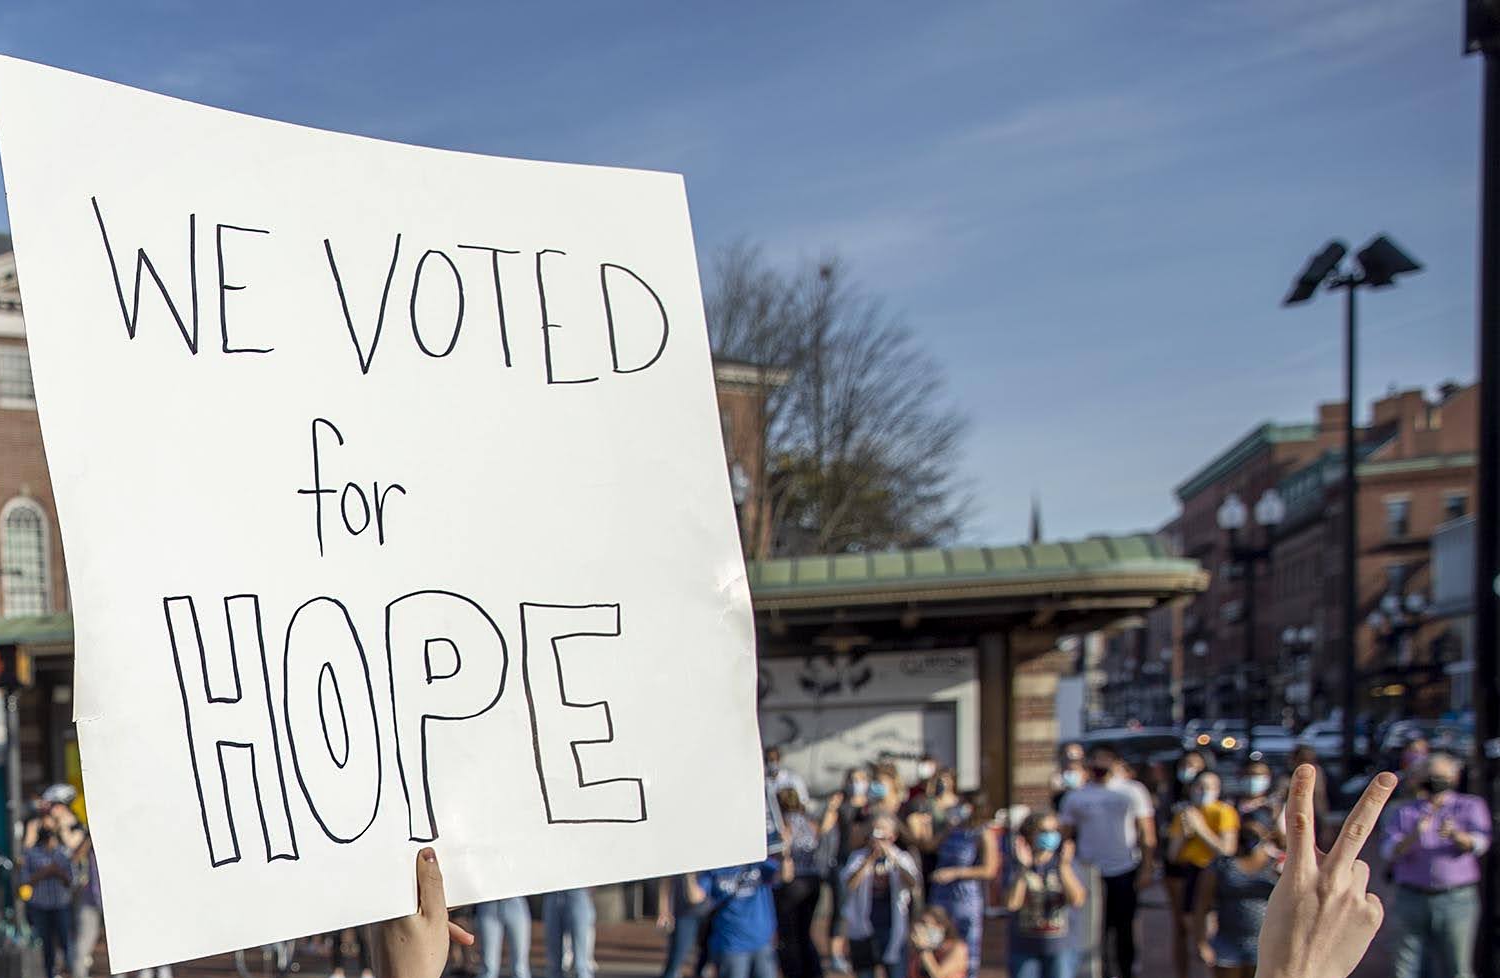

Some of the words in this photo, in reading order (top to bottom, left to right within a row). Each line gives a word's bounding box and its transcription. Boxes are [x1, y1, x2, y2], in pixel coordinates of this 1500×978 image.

[91, 196, 275, 356] WE
[323, 233, 669, 385] VOTED
[297, 417, 407, 557] for
[163, 589, 648, 869] HOPE
